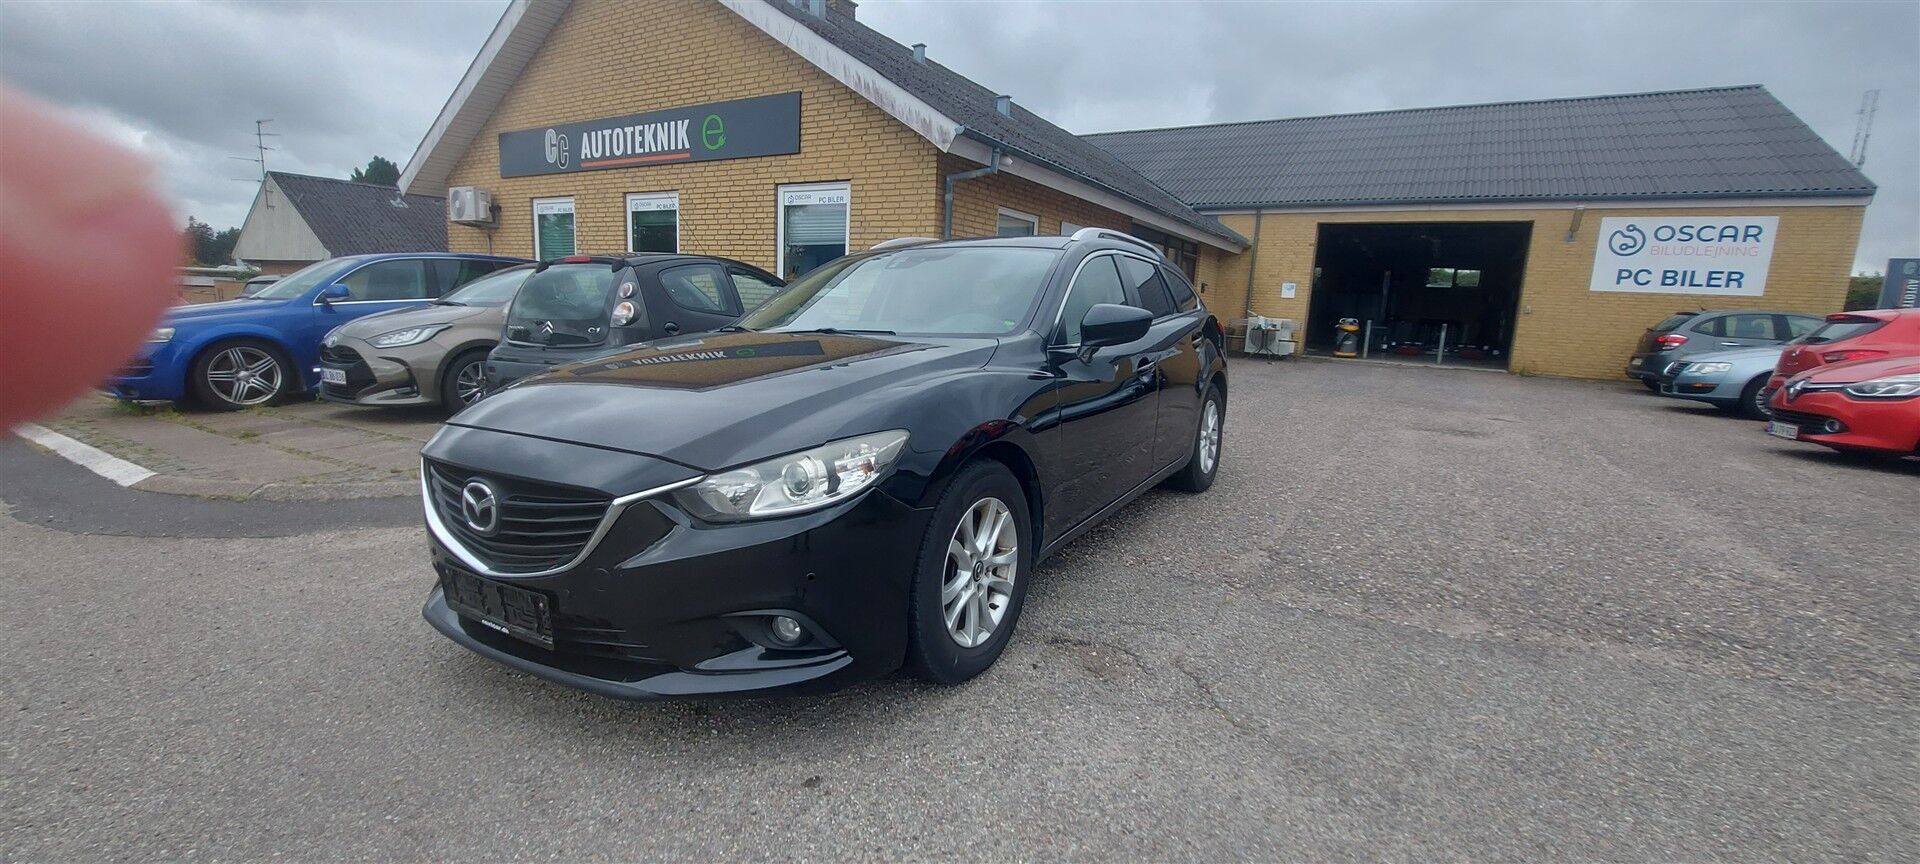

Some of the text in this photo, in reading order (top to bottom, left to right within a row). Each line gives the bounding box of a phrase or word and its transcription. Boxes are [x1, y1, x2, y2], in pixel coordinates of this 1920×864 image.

[580, 119, 691, 160] AUTOTEKNIK
[818, 195, 844, 204] PC BILER
[1653, 224, 1764, 243] OSCAR
[1649, 244, 1759, 258] BILUDLEJNING
[1615, 268, 1746, 289] PC BILER
